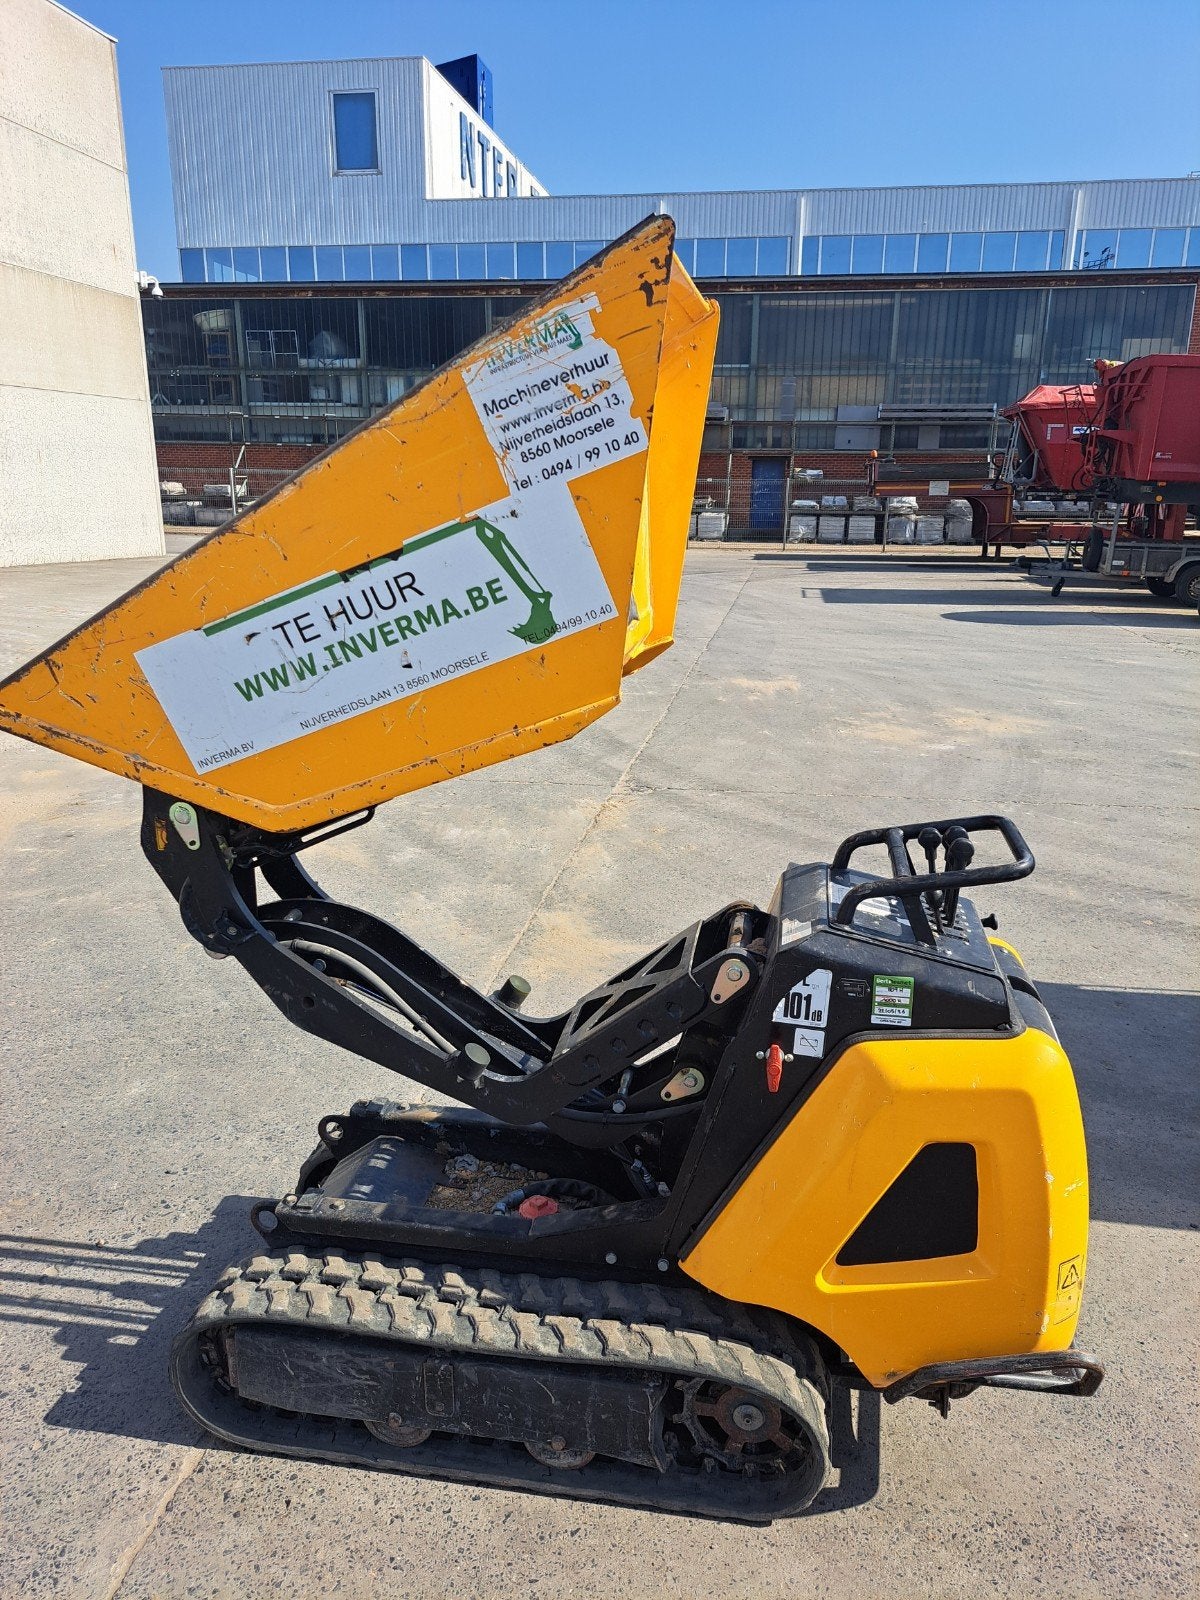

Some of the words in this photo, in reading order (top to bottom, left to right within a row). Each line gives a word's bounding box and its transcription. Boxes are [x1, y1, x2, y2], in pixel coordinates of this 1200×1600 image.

[556, 334, 573, 346] MAES
[482, 351, 610, 417] Machineverhuur
[500, 379, 611, 434] www.inverma.b
[499, 403, 602, 453] Nijverheidslaan
[604, 393, 625, 409] 13,
[520, 441, 552, 463] 8560
[552, 417, 615, 450] Moorsele
[541, 458, 573, 480] 0494
[585, 447, 600, 462] 99
[606, 439, 621, 455] 10
[624, 430, 640, 447] 40
[271, 611, 321, 649] TE
[323, 571, 425, 632] HUUR
[233, 577, 509, 702] WWW.INVERMA.BE
[300, 688, 391, 731] NIJVERHEIDSLAAN
[393, 683, 405, 695] 13
[406, 674, 430, 690] 8560
[430, 650, 490, 681] MOORSELE
[197, 746, 240, 769] INVERMA
[240, 740, 256, 755] BV
[783, 991, 812, 1021] 101
[811, 1009, 823, 1022] dB
